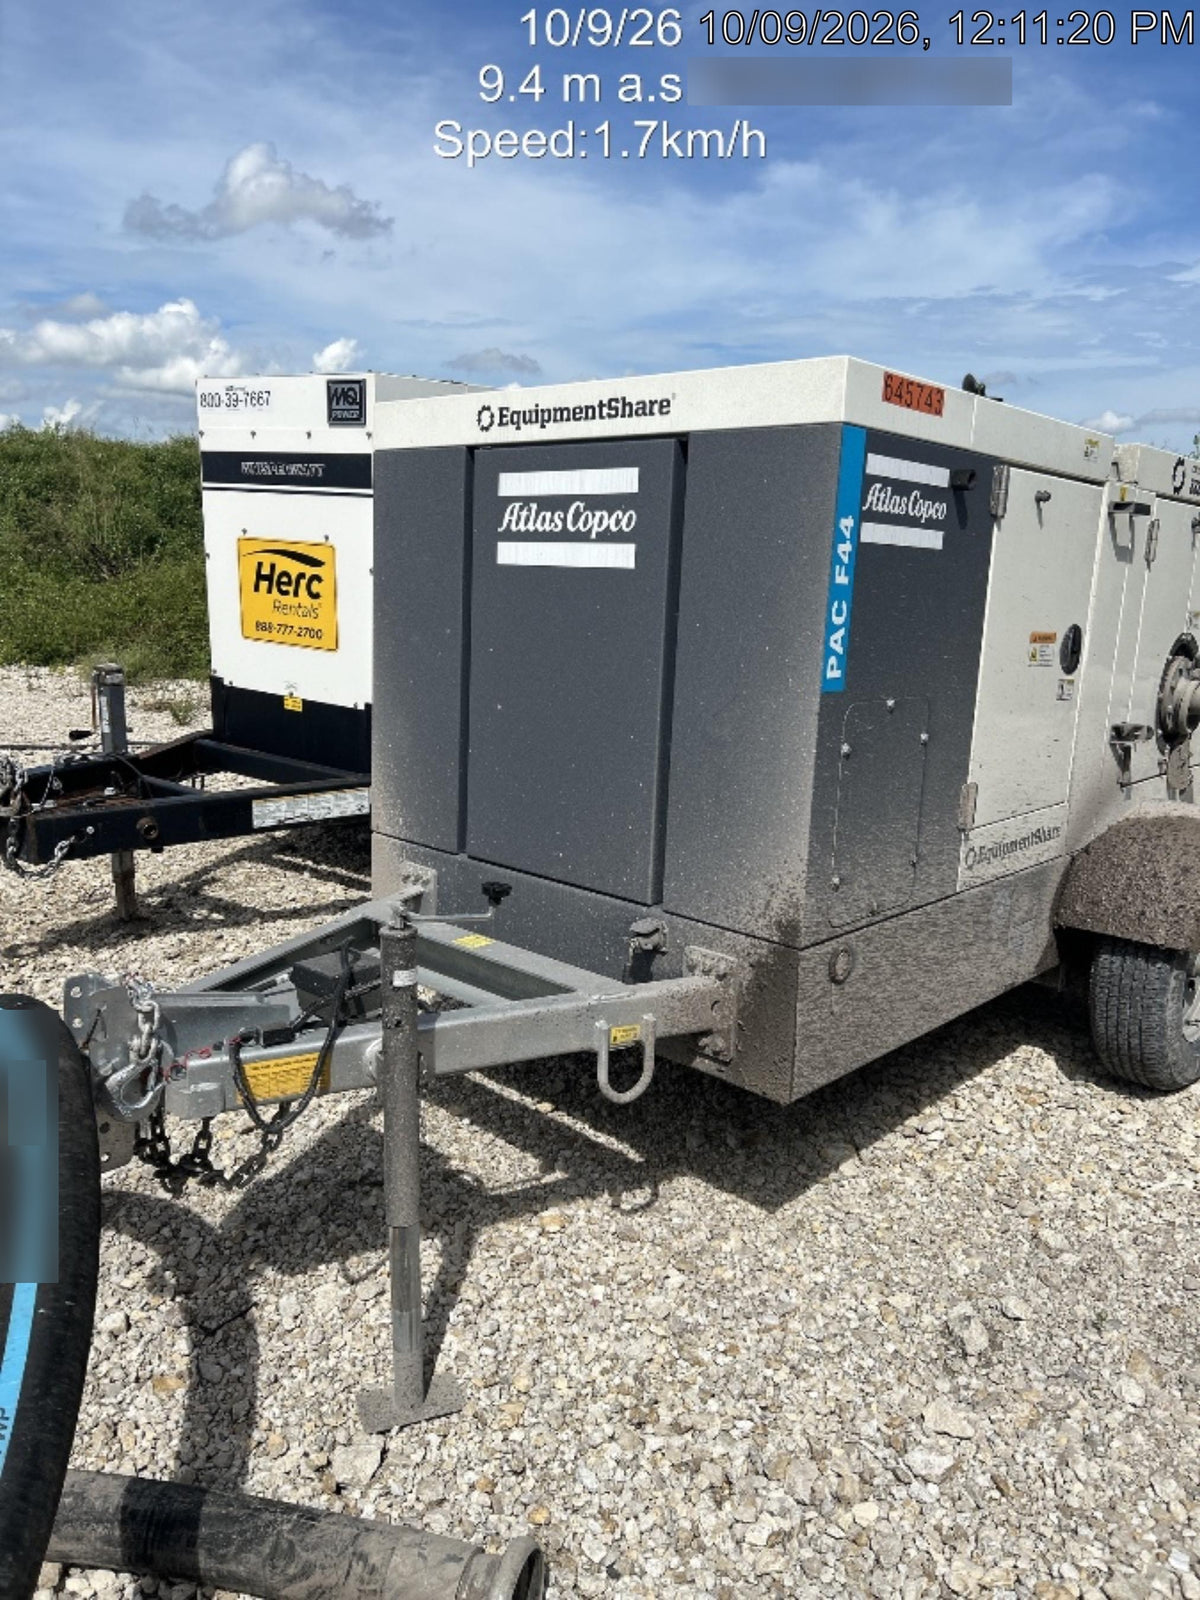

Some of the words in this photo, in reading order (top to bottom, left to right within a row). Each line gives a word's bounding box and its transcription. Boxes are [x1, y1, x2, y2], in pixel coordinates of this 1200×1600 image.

[330, 386, 361, 407] MQ
[497, 396, 671, 430] EquipmentShare
[883, 373, 944, 416] 645743
[497, 502, 565, 533] Atlas
[566, 501, 637, 540] Copco
[862, 482, 908, 515] Atlas
[908, 490, 947, 523] Copco
[834, 515, 855, 586] F44
[253, 561, 325, 600] Herc
[272, 599, 320, 619] Rentals
[255, 620, 323, 640] 888-777-2700
[826, 600, 847, 679] PAC
